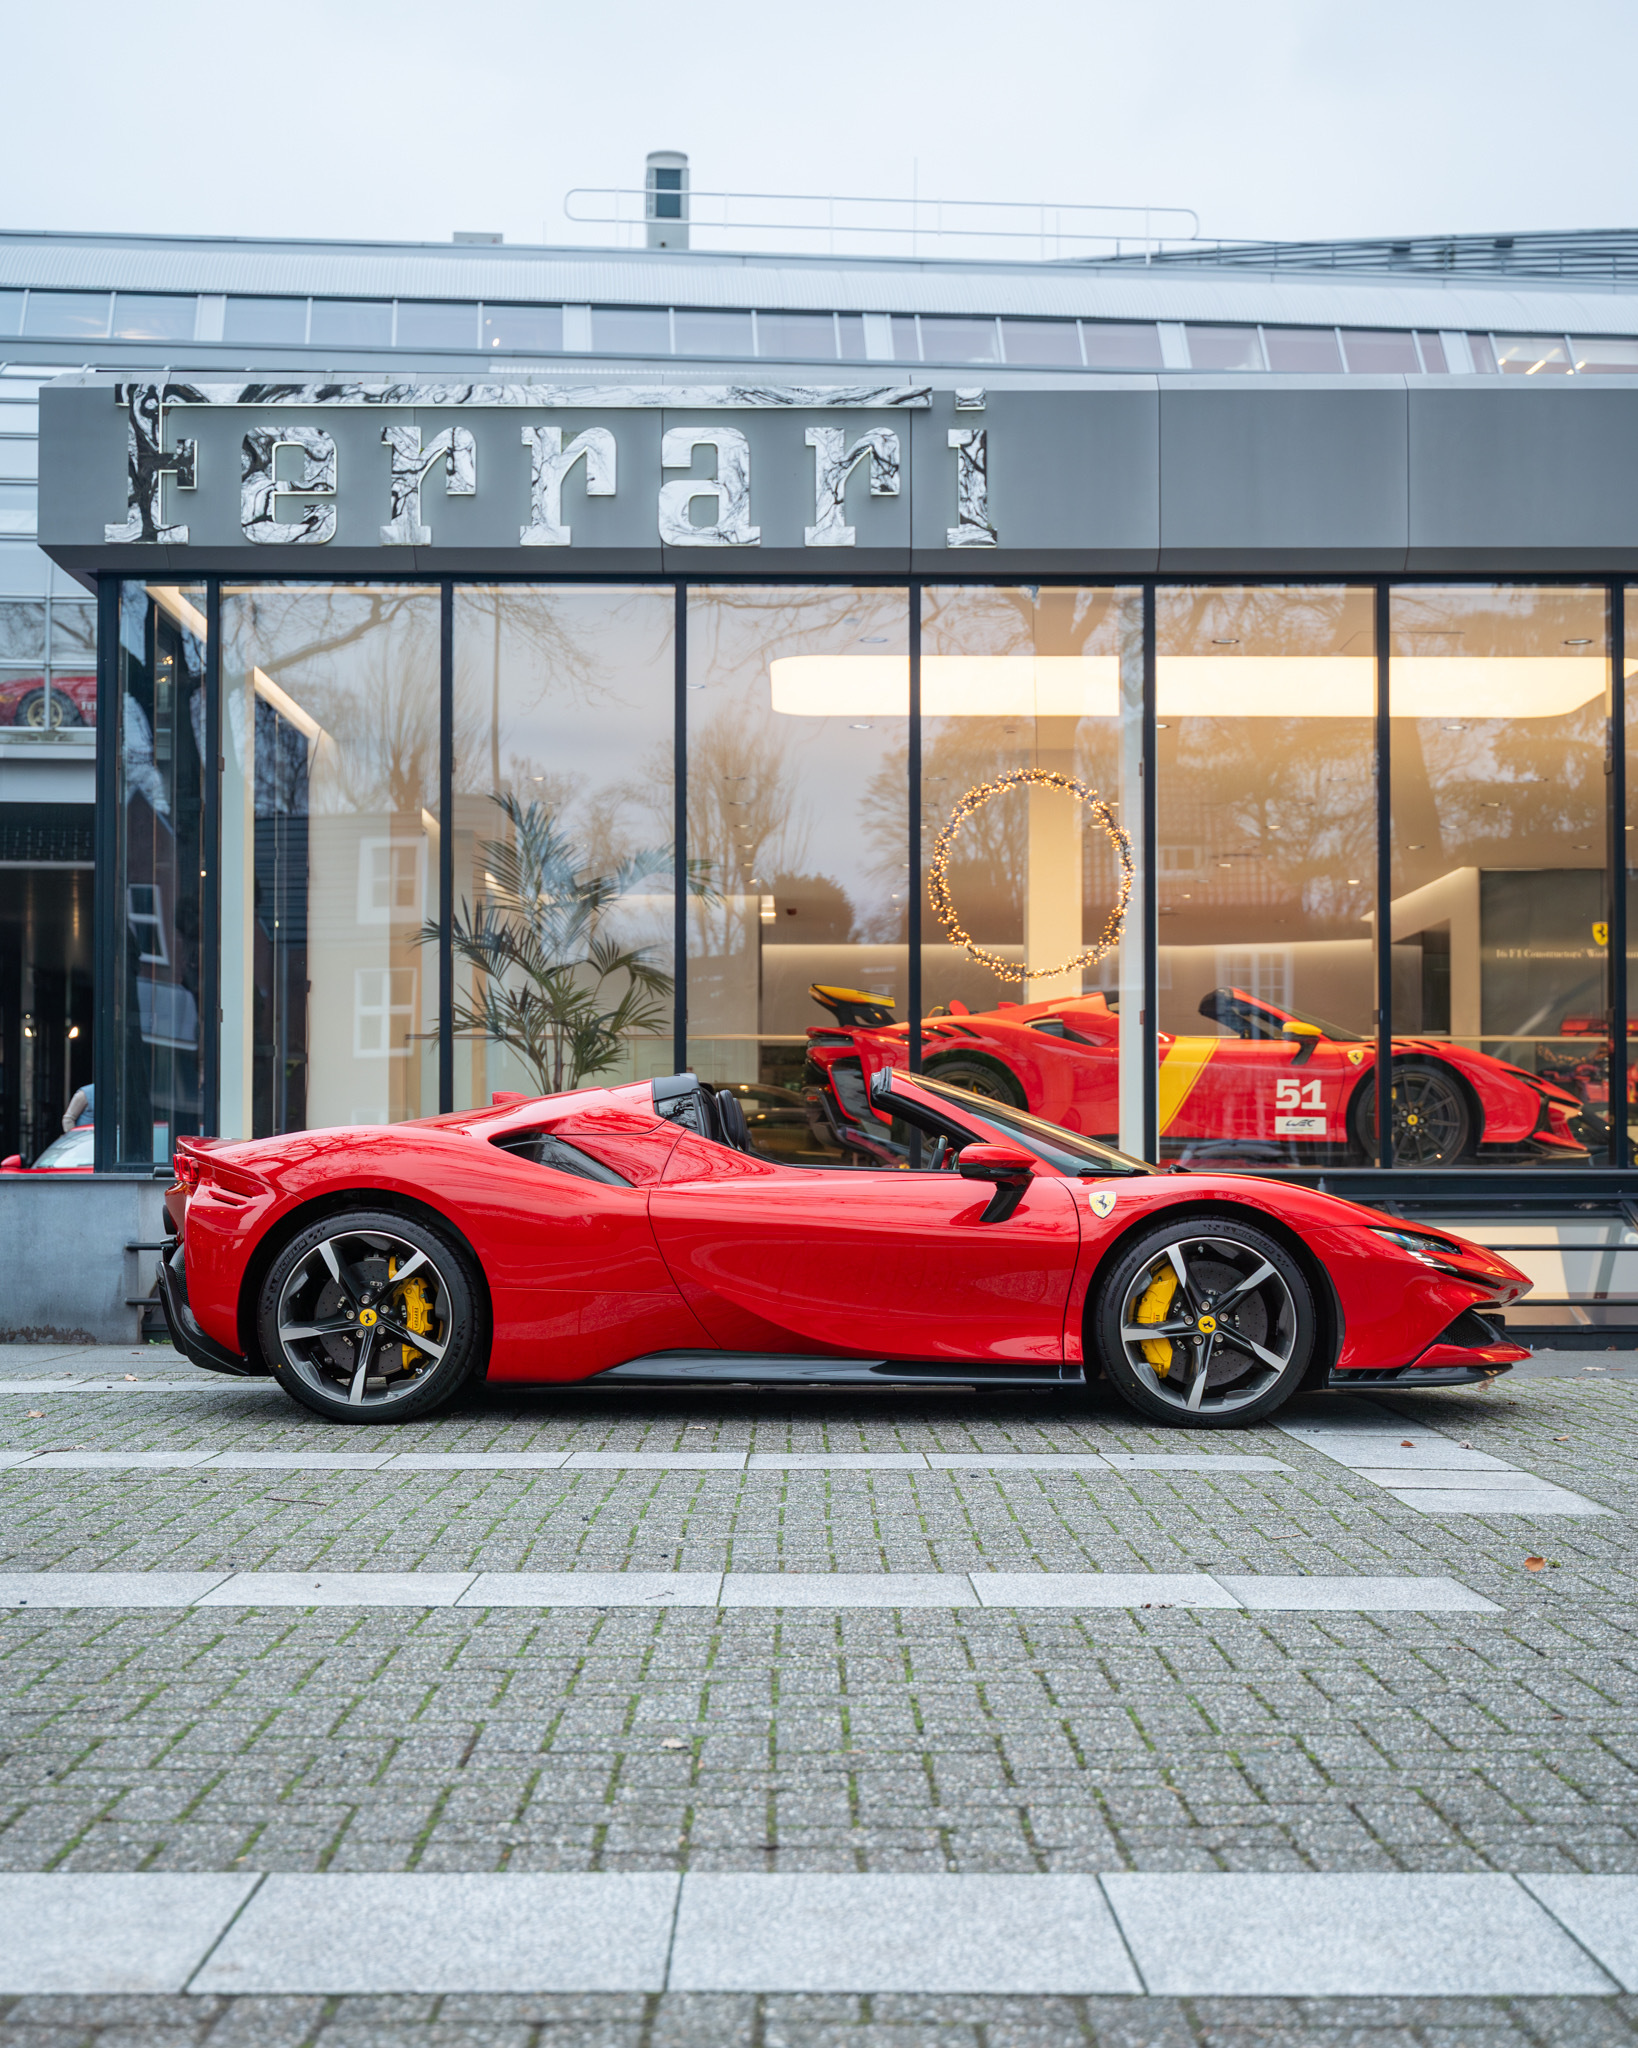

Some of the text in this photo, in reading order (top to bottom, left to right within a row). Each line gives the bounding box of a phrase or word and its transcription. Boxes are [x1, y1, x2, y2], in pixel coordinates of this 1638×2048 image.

[104, 383, 998, 547] Ferrari
[1276, 1079, 1327, 1109] 51
[1234, 1228, 1275, 1254] MICHELIN
[273, 1239, 307, 1282] MICHELIN
